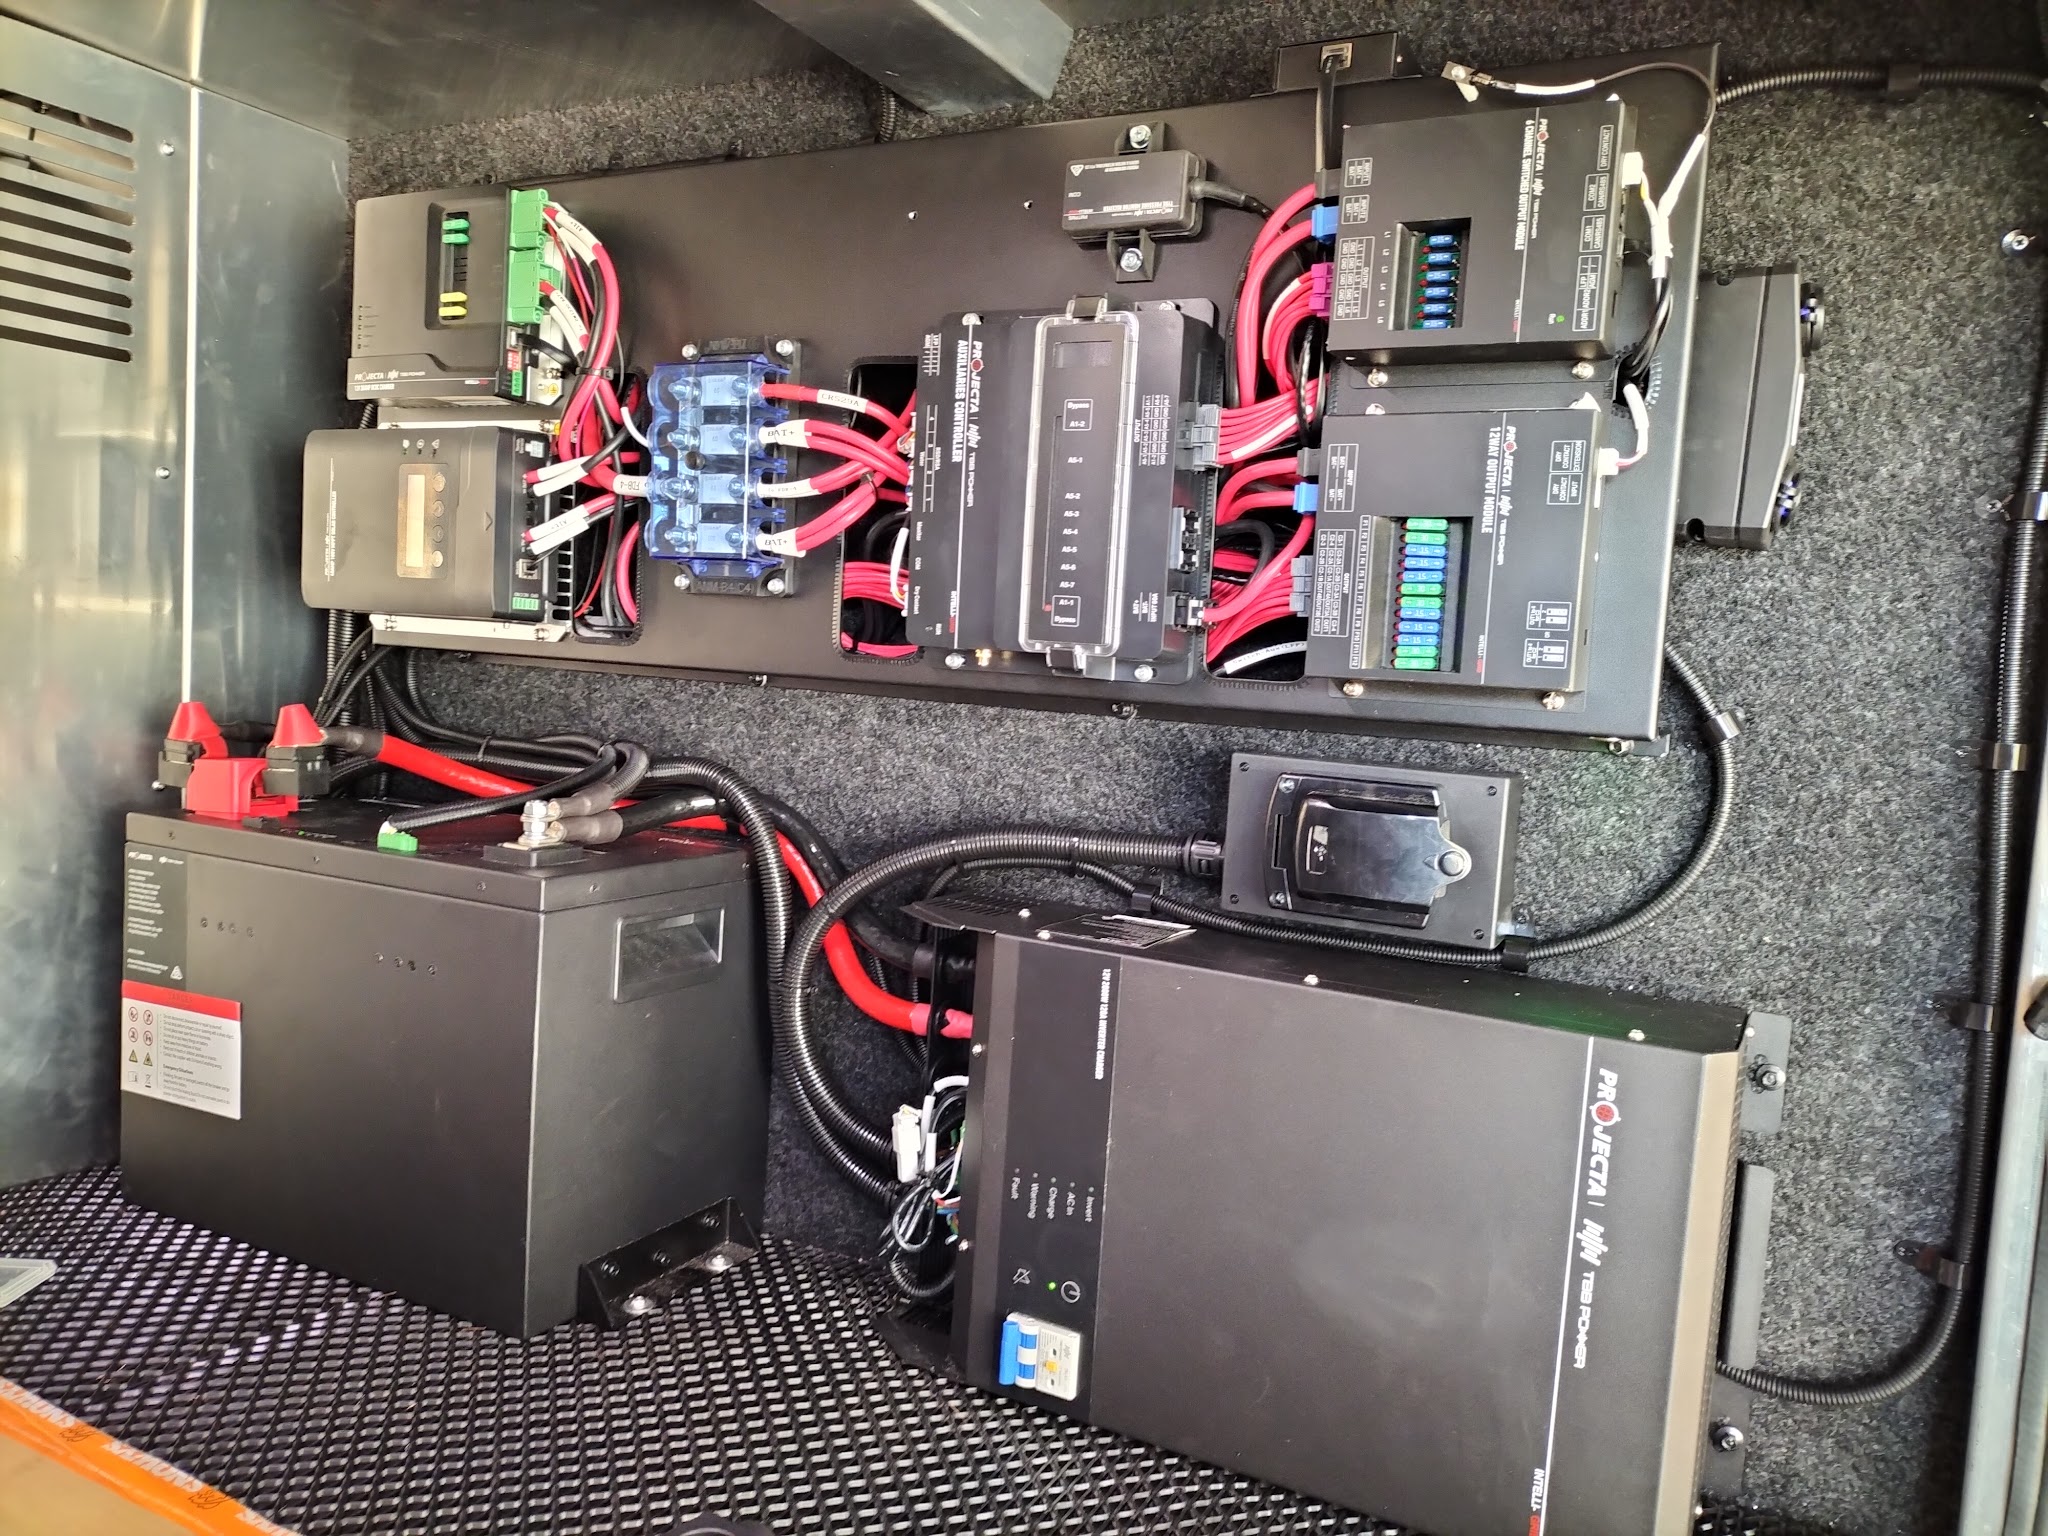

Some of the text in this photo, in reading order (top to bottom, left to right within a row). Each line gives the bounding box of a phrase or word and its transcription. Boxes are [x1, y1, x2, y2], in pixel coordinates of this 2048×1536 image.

[1522, 126, 1535, 158] CHANNEL
[1535, 118, 1549, 171] PROJECTA
[1601, 130, 1610, 155] CONTACT
[1519, 158, 1532, 194] SWITCHED
[1586, 184, 1597, 201] COM2
[1516, 194, 1529, 221] OUTPUT
[1514, 222, 1527, 250] MODULE
[1583, 226, 1593, 242] COM1
[1361, 267, 1370, 289] OUTPUT
[1580, 276, 1589, 288] LFP
[970, 341, 985, 414] PROJECTA
[951, 339, 968, 462] AUXILIARIES CONTROLLER
[767, 429, 795, 438] BAT+
[1133, 419, 1141, 443] OUTPUT
[1501, 426, 1518, 488] PROJECTA
[1561, 444, 1570, 469] CONTACT
[1480, 427, 1502, 534] 12WAY OUTPUT MODULE
[1559, 477, 1568, 501] CONTACT
[764, 538, 787, 546] BAT+
[916, 521, 924, 541] Monitor
[1342, 573, 1351, 594] OUTPUT
[1097, 1019, 1107, 1050] INVERTER
[1095, 1050, 1105, 1080] CHARGER
[1587, 1067, 1621, 1197] PROJECTA
[1011, 1177, 1021, 1200] Fault
[1027, 1182, 1040, 1219] Warning
[1066, 1191, 1076, 1206] AC
[1046, 1186, 1058, 1220] Charge
[1084, 1196, 1095, 1222] Invert
[1573, 1271, 1596, 1369] TBB POWER
